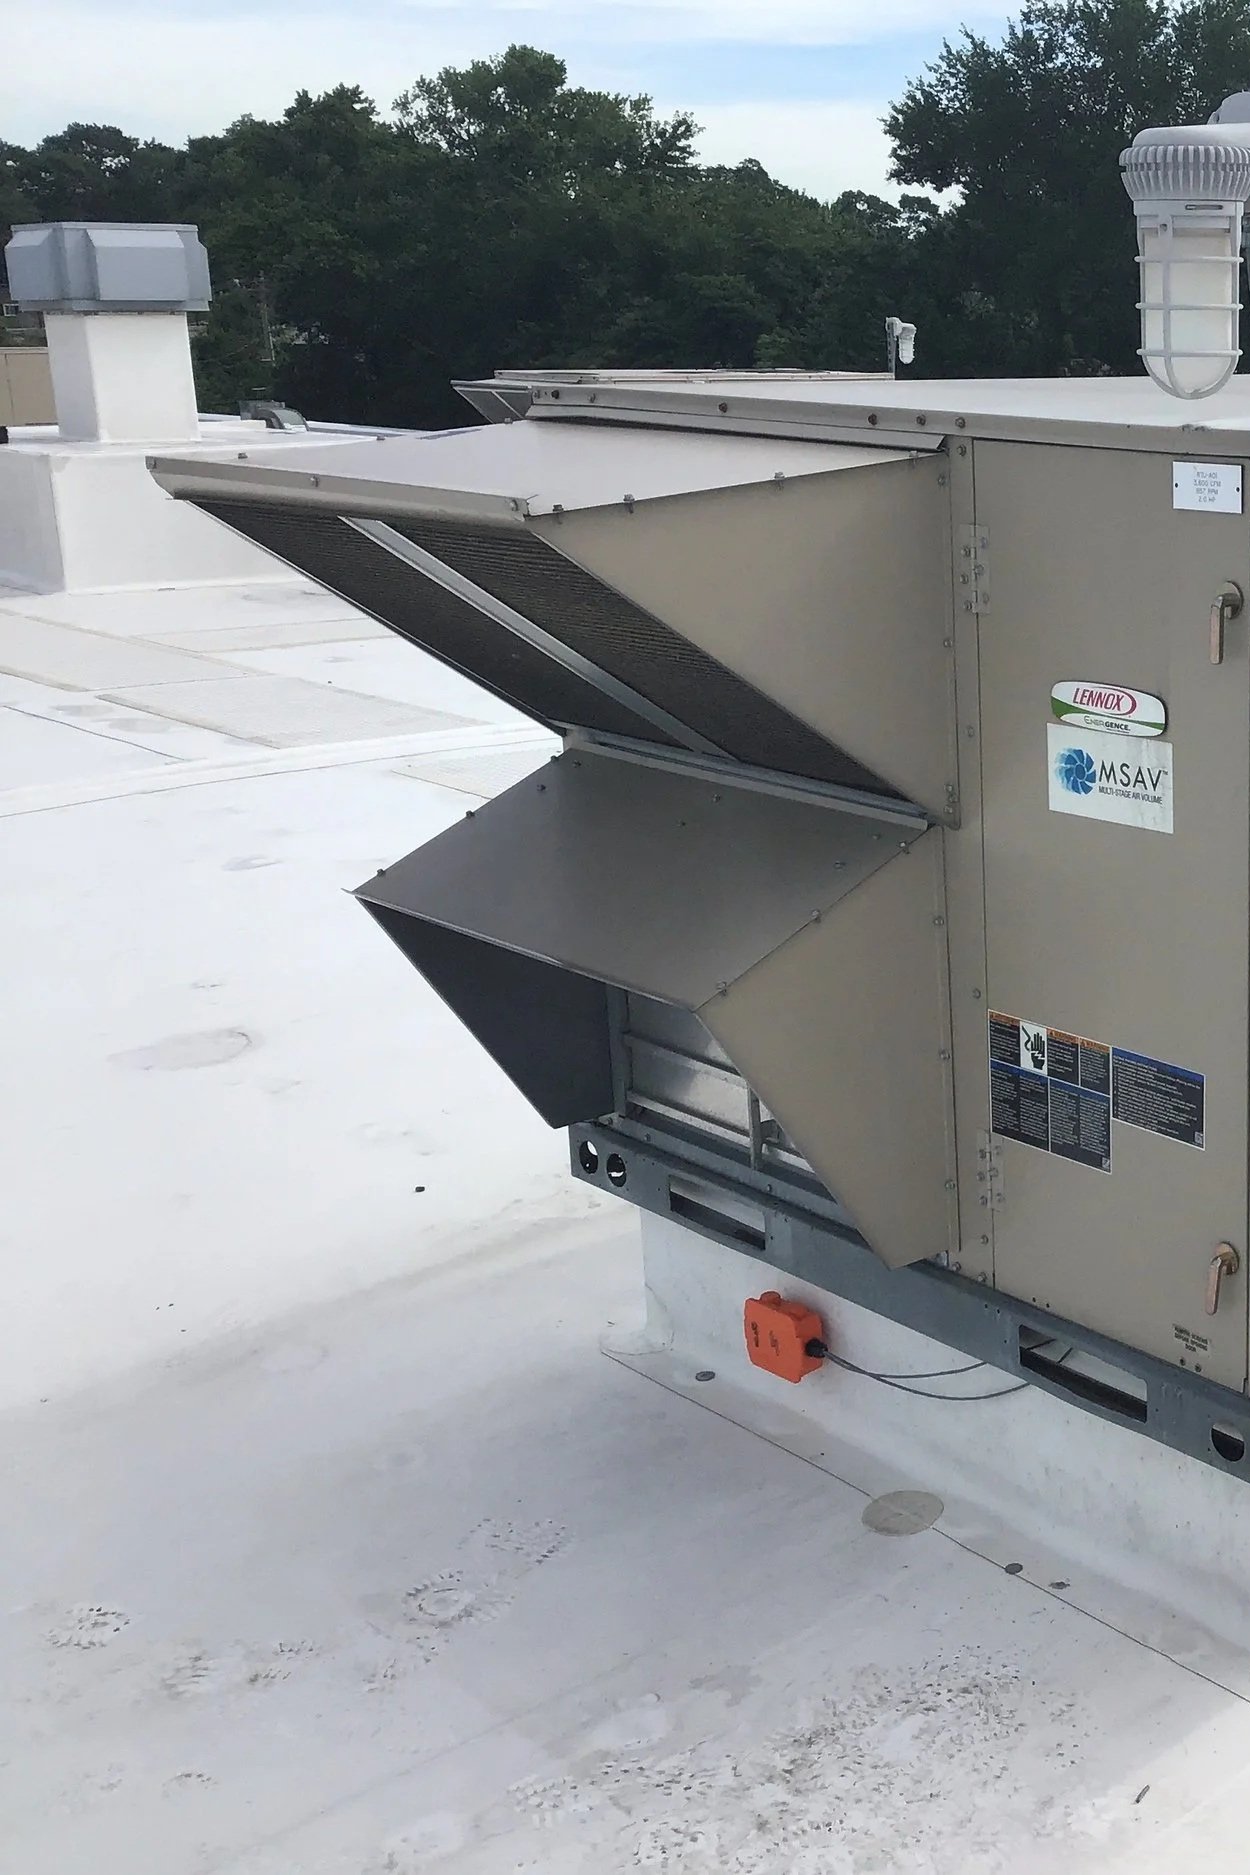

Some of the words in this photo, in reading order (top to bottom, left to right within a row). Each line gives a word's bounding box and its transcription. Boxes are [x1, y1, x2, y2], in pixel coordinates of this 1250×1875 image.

[1072, 687, 1125, 712] LENNOX
[1098, 785, 1131, 800] MULTI-STAGE
[1131, 792, 1141, 801] AIR
[1141, 794, 1163, 805] VOLUME
